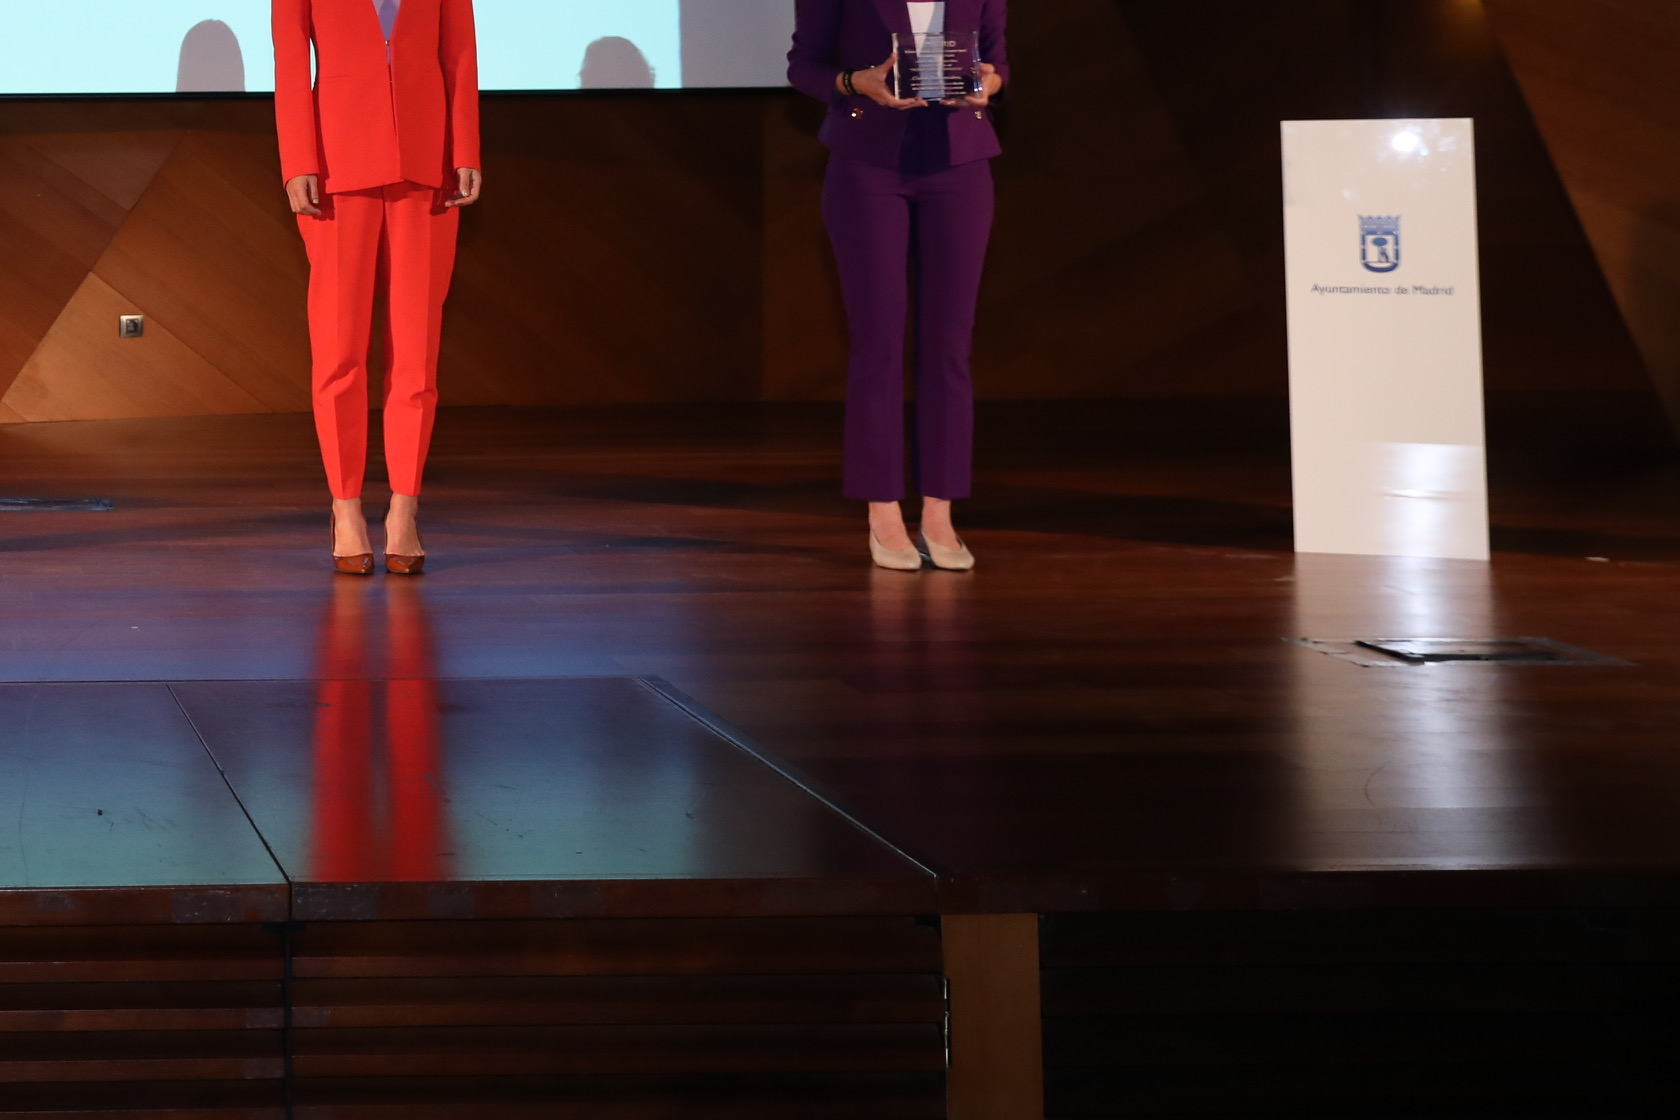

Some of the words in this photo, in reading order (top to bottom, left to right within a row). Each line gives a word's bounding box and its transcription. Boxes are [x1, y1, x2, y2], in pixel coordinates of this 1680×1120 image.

[1311, 283, 1390, 296] Ayuntamiento
[1394, 284, 1408, 295] de
[1412, 284, 1453, 296] Madrid
